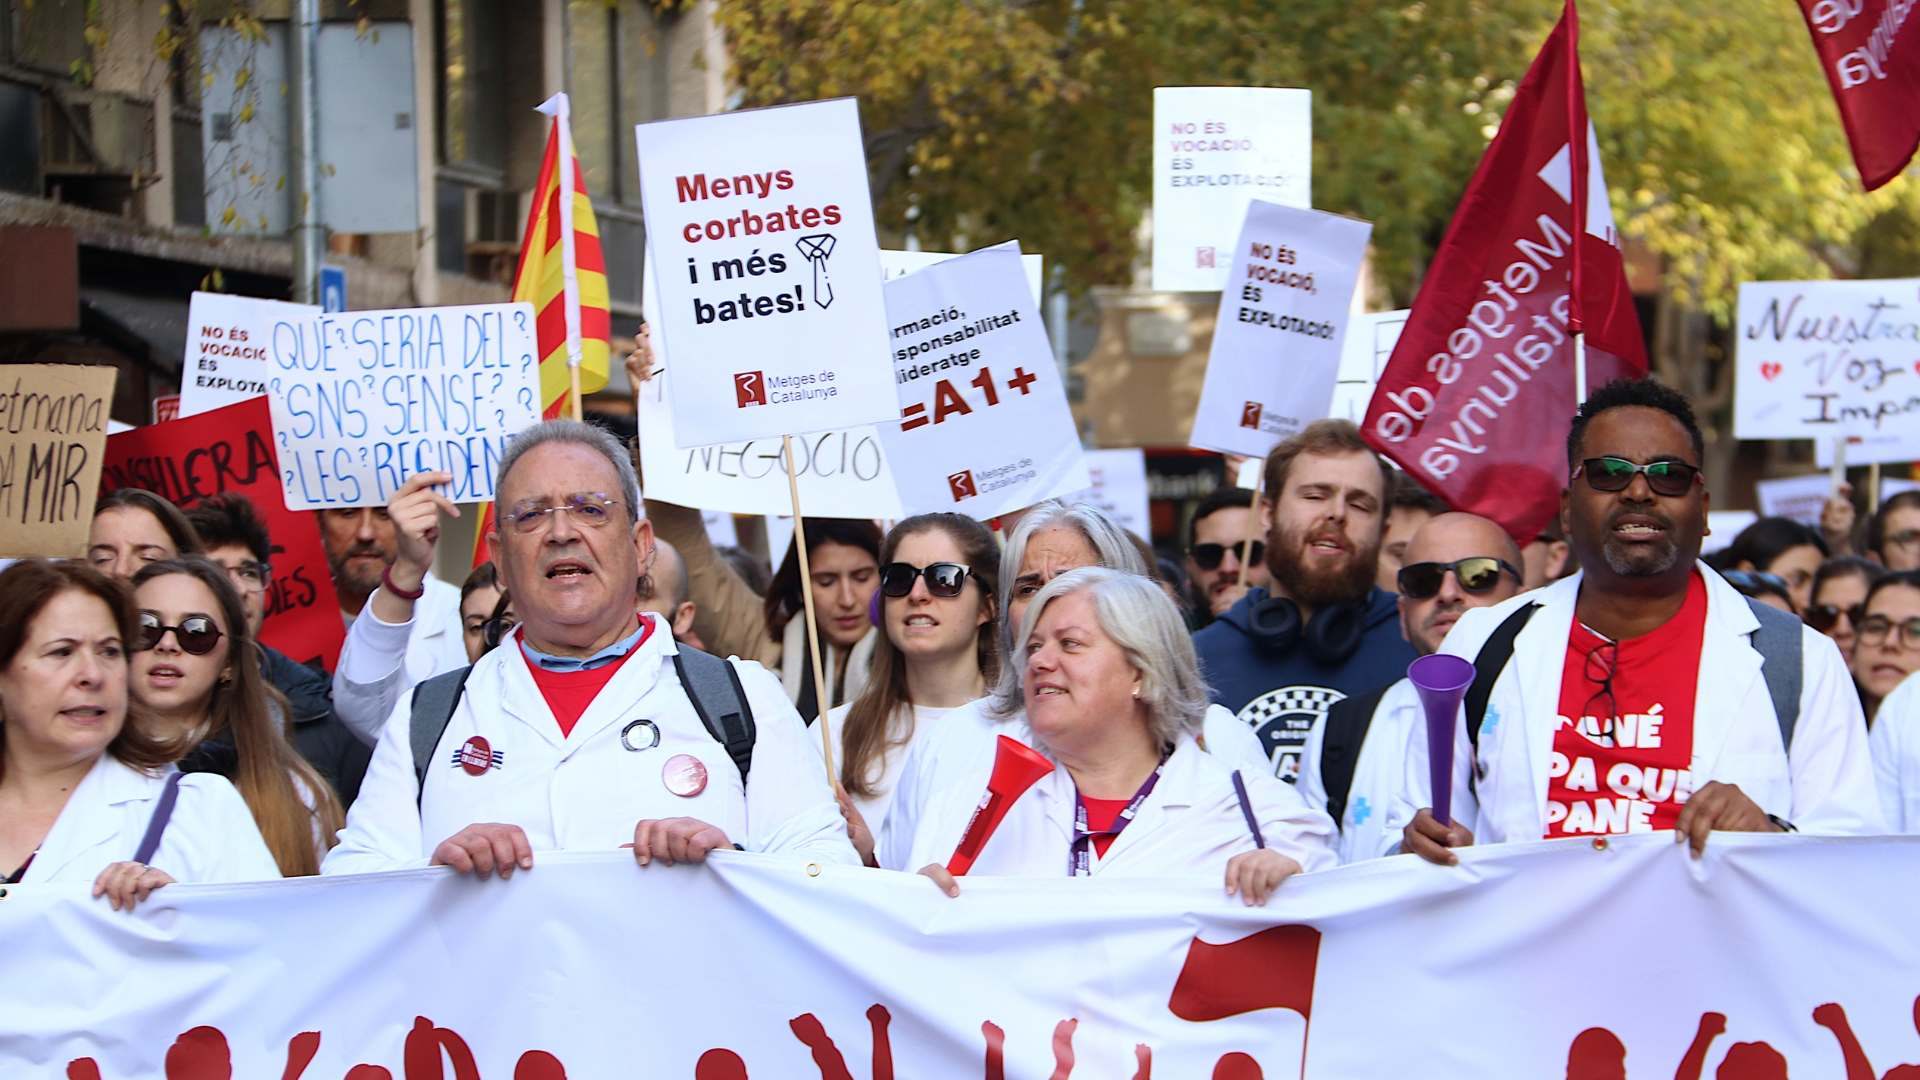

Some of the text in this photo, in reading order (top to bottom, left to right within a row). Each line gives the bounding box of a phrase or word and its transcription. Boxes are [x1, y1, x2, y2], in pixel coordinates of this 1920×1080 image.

[1171, 119, 1226, 135] NO ÉS
[1171, 155, 1194, 170] ÉS
[676, 169, 794, 203] Menys
[683, 204, 842, 243] corbates
[688, 248, 787, 284] i més
[1250, 242, 1272, 260] NO
[1277, 244, 1297, 265] ÉS
[1242, 281, 1262, 302] ÉS
[1247, 263, 1317, 295] VOCACIÓ,
[693, 284, 805, 325] bates!
[201, 325, 248, 342] NO ÉS
[1238, 307, 1336, 340] EXPLOTACIÓ!
[352, 314, 446, 370] SERIA
[464, 312, 511, 369] DEL
[197, 356, 217, 372] ÉS
[1804, 349, 1905, 392] Voz
[196, 376, 267, 393] EXPLOTA
[768, 370, 835, 389] Metges de
[287, 379, 368, 439] SNS
[382, 372, 487, 436] SENSE
[770, 386, 837, 404] Catalunya
[21, 440, 88, 524] MIR
[295, 447, 361, 503] LES
[975, 457, 1033, 481] Metges de
[979, 468, 1037, 494] Catalunya
[1285, 719, 1309, 729] THE
[1550, 751, 1599, 792] PA
